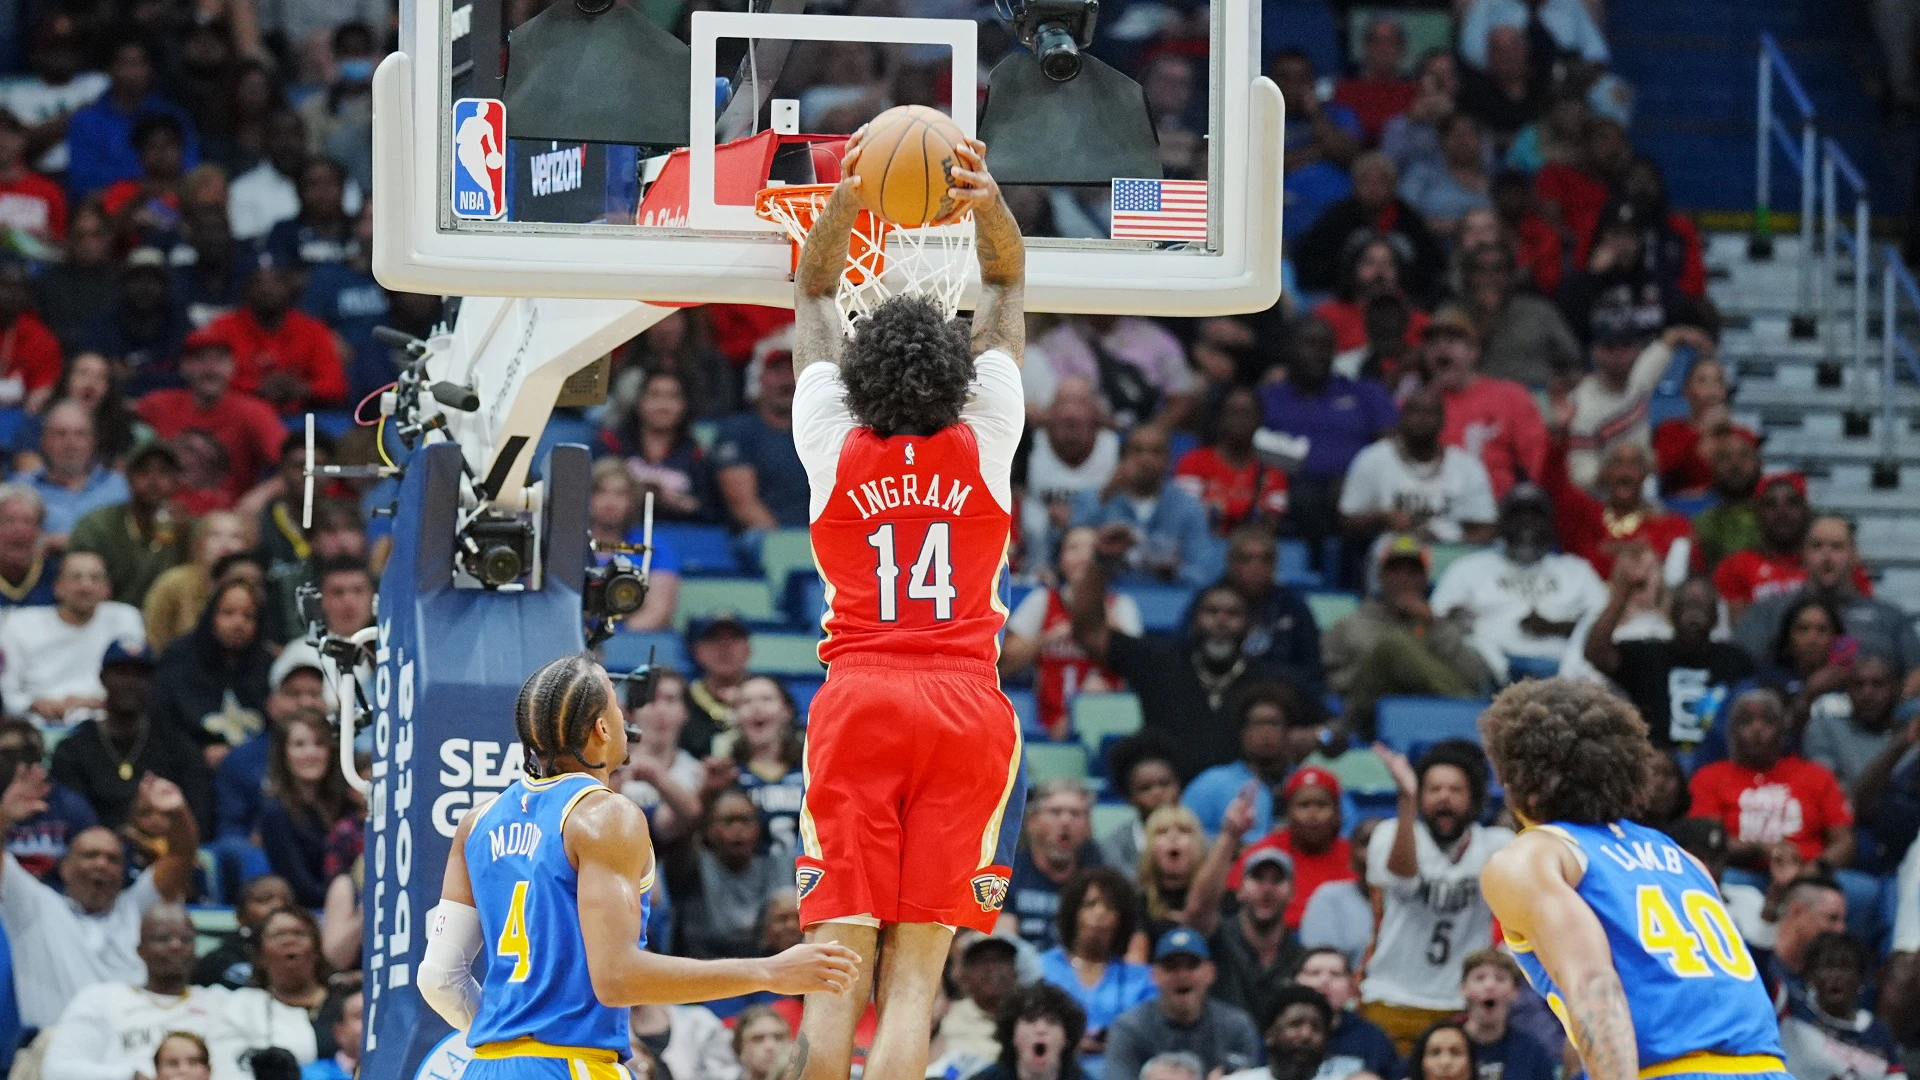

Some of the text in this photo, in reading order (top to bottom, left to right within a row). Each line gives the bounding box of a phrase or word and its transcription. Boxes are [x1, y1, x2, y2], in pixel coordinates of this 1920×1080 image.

[531, 141, 582, 197] verizon
[459, 191, 485, 211] NBA
[847, 473, 973, 520] INGRAM
[866, 521, 958, 622] 14
[439, 738, 527, 788] SEA
[497, 880, 530, 983] 4
[1425, 920, 1454, 968] 5
[1636, 884, 1757, 982] 40
